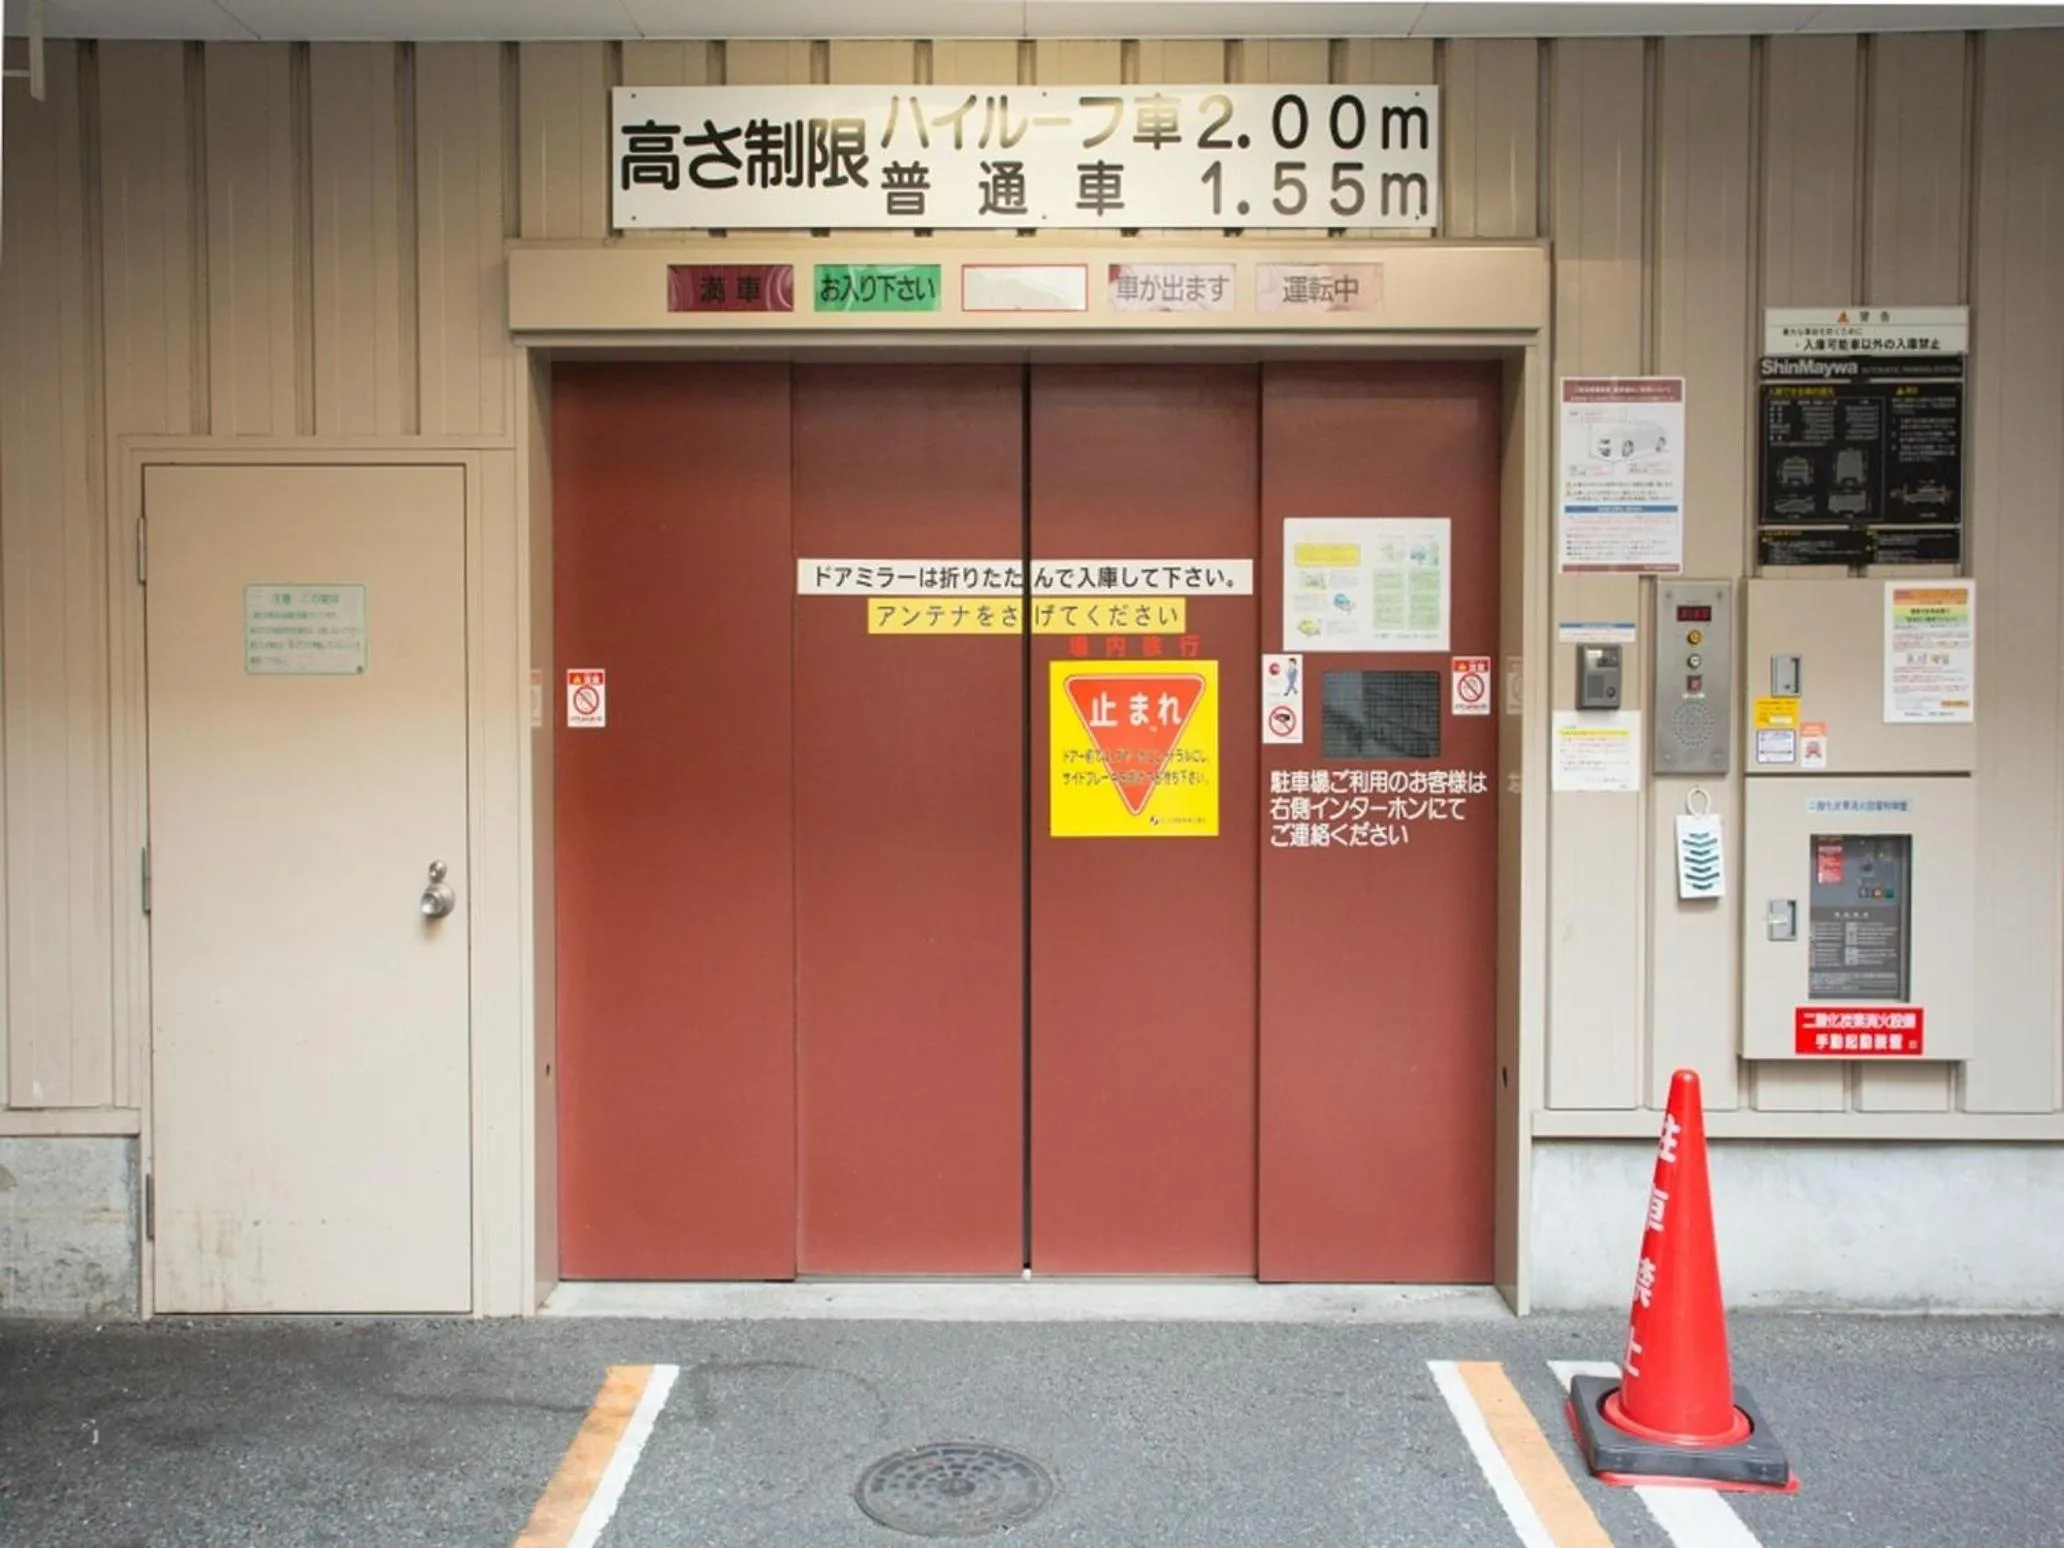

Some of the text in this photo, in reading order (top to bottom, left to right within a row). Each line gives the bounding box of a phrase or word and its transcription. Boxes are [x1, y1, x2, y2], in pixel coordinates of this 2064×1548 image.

[881, 93, 1429, 150] ハイルーフ車 2.00m
[621, 119, 869, 191] 高さ制限
[881, 159, 1428, 216] 普通車 1.55m
[700, 275, 762, 302] 満車
[820, 275, 935, 303] お入り下さい
[1116, 274, 1230, 302] 車が出ます
[1282, 275, 1359, 303] 運転中
[1761, 360, 1858, 377] ShinMaywa
[877, 605, 1178, 627] アンテナをさげてください
[1089, 691, 1182, 728] 止まれ
[1270, 769, 1488, 794] 駐車場ご利用のお客様は
[1270, 797, 1466, 821] 右側インターホンにて
[1270, 821, 1409, 847] ご連絡ください
